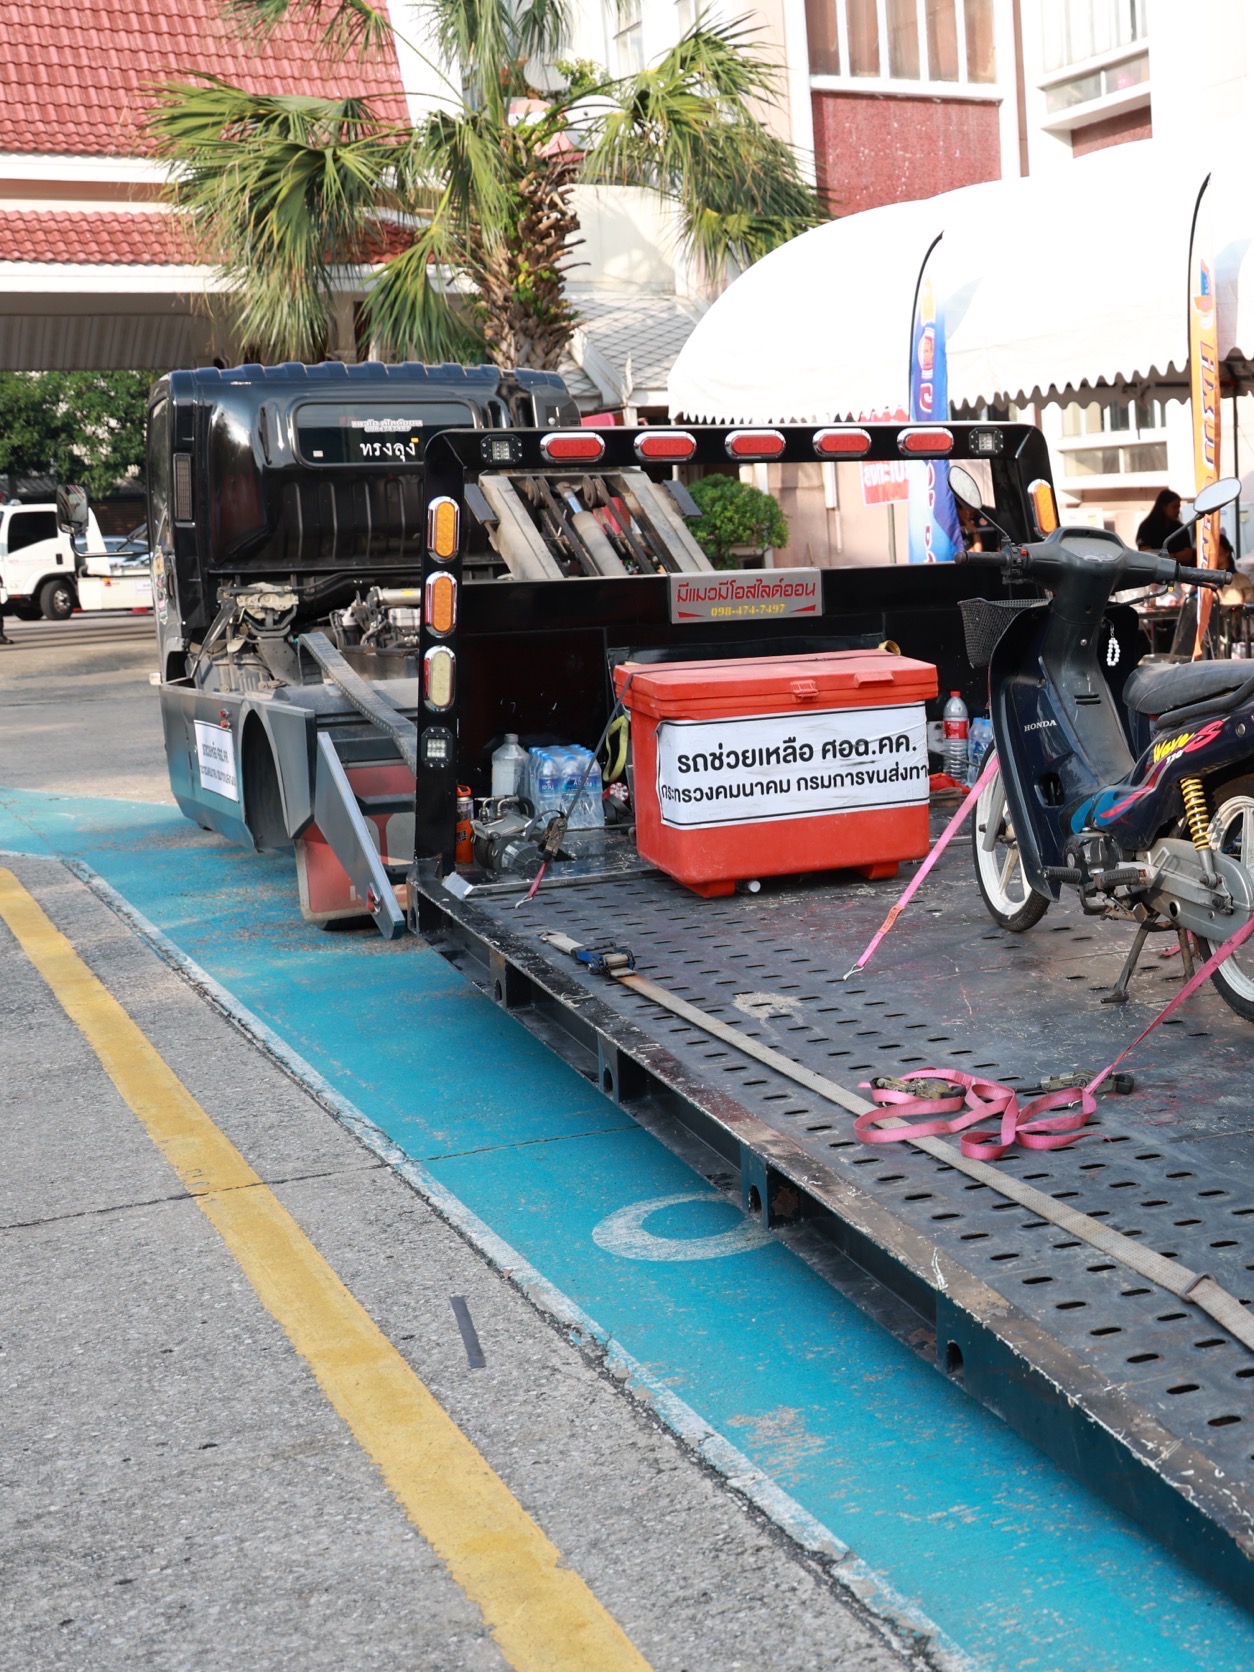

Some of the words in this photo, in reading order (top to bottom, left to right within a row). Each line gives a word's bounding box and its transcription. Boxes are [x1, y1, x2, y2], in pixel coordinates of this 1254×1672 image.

[710, 603, 786, 617] 098-474-7497
[1024, 719, 1057, 732] HONDA
[677, 736, 814, 774] รถช่วยเหลือ
[1153, 733, 1195, 763] Wave
[1166, 749, 1184, 765] 110
[661, 777, 791, 803] กระทรวงคมนาคม
